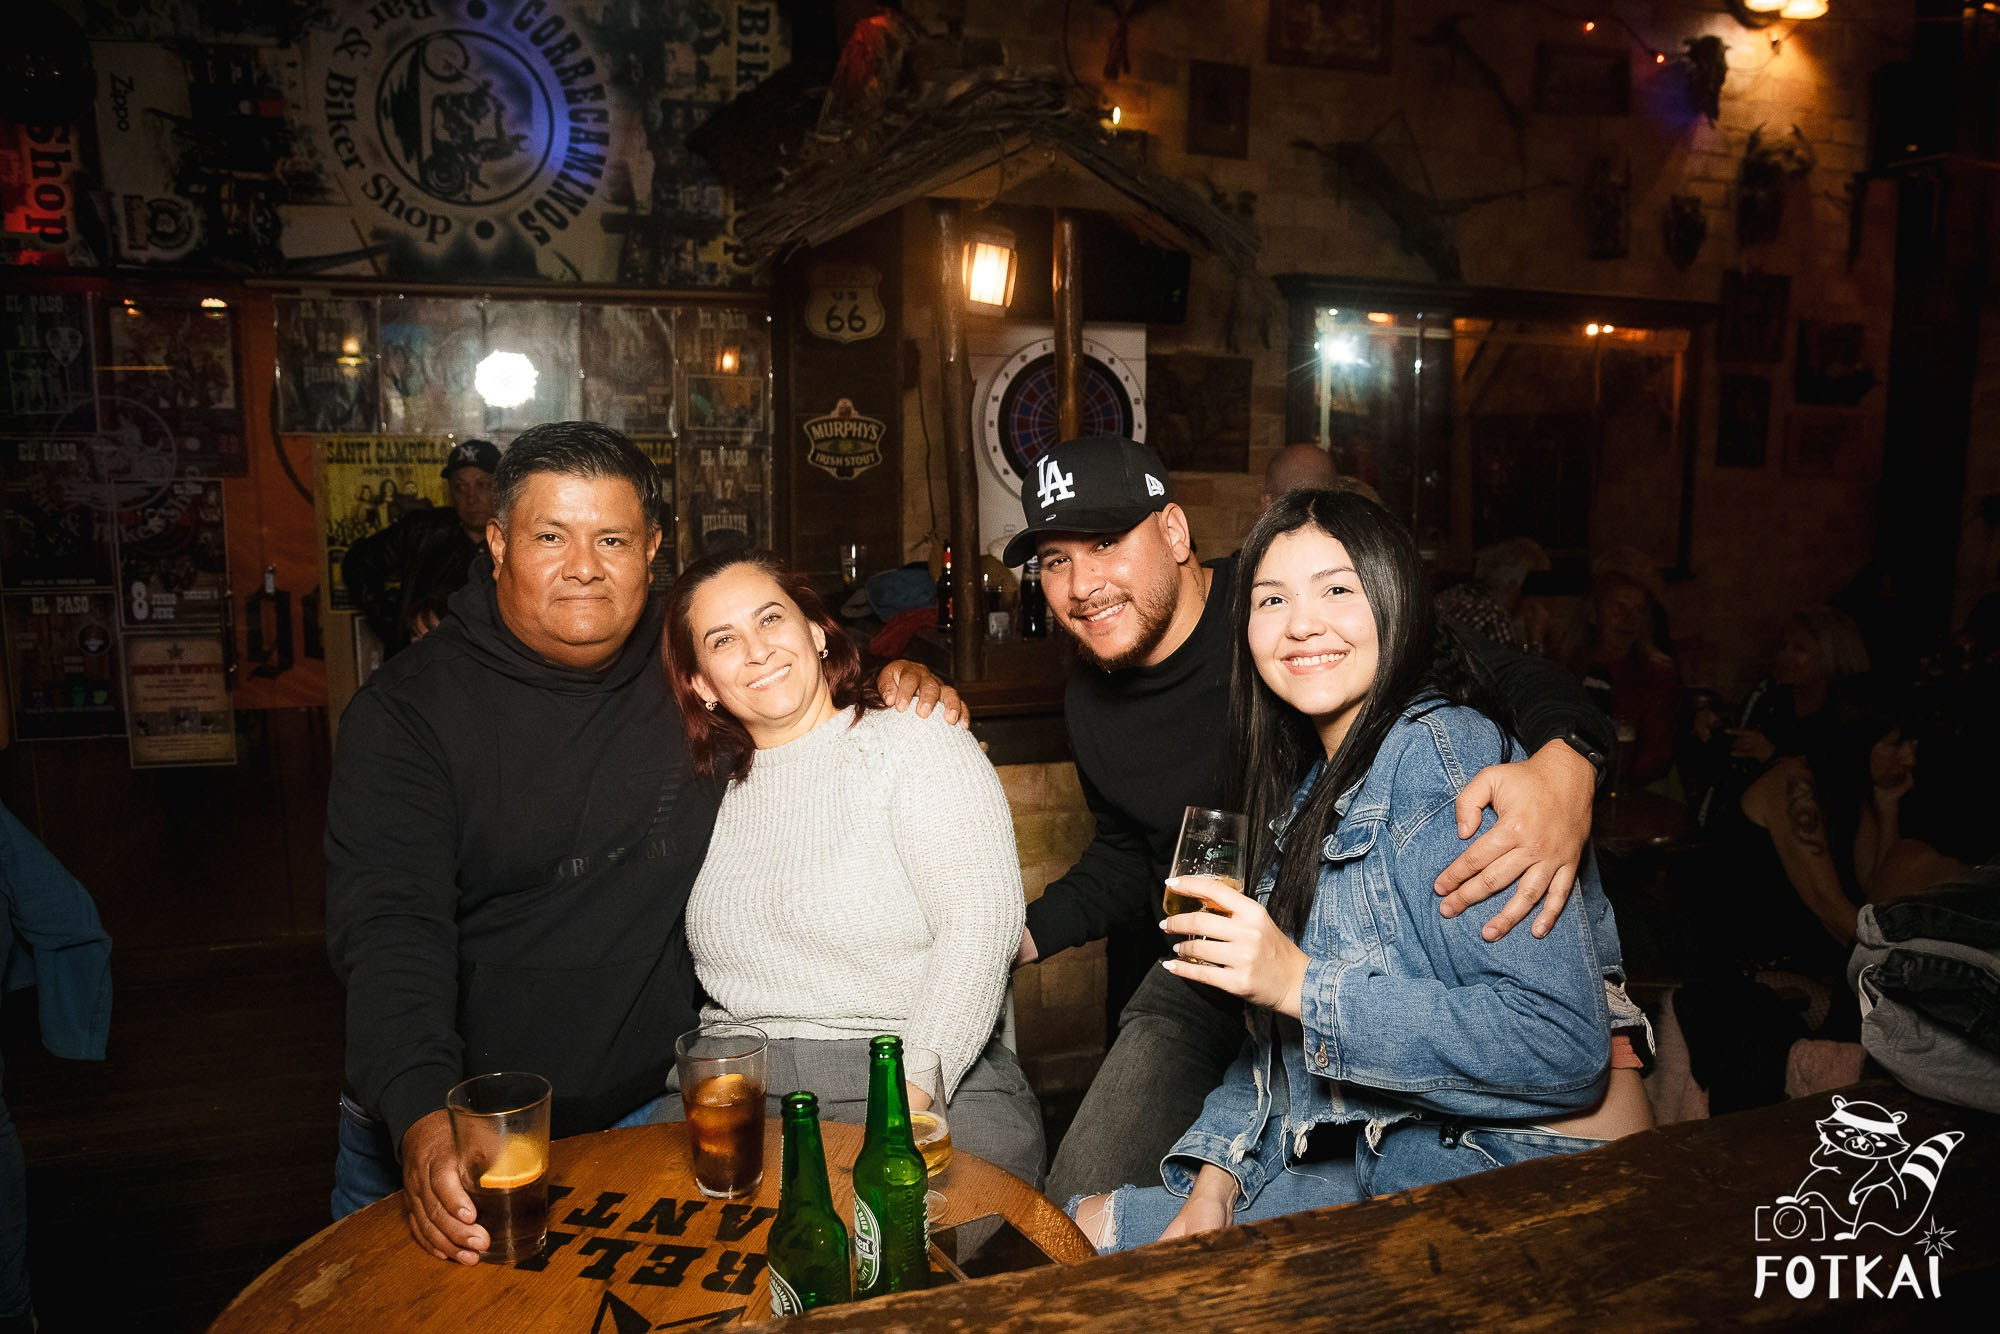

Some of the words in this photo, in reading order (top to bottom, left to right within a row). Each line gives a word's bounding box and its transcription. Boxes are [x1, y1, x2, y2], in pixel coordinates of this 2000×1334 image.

[334, 27, 372, 58] &
[110, 72, 135, 133] Zippo
[324, 69, 366, 171] Biker
[513, 0, 610, 246] CORRECAMINOS
[361, 172, 452, 243] Shop
[826, 303, 866, 333] 66
[327, 441, 371, 464] SANTI
[815, 452, 843, 467] IRISH
[844, 452, 875, 468] STOUT
[1036, 454, 1076, 509] LA
[31, 595, 49, 615] EL
[55, 594, 90, 615] PASO
[130, 580, 150, 621] 8
